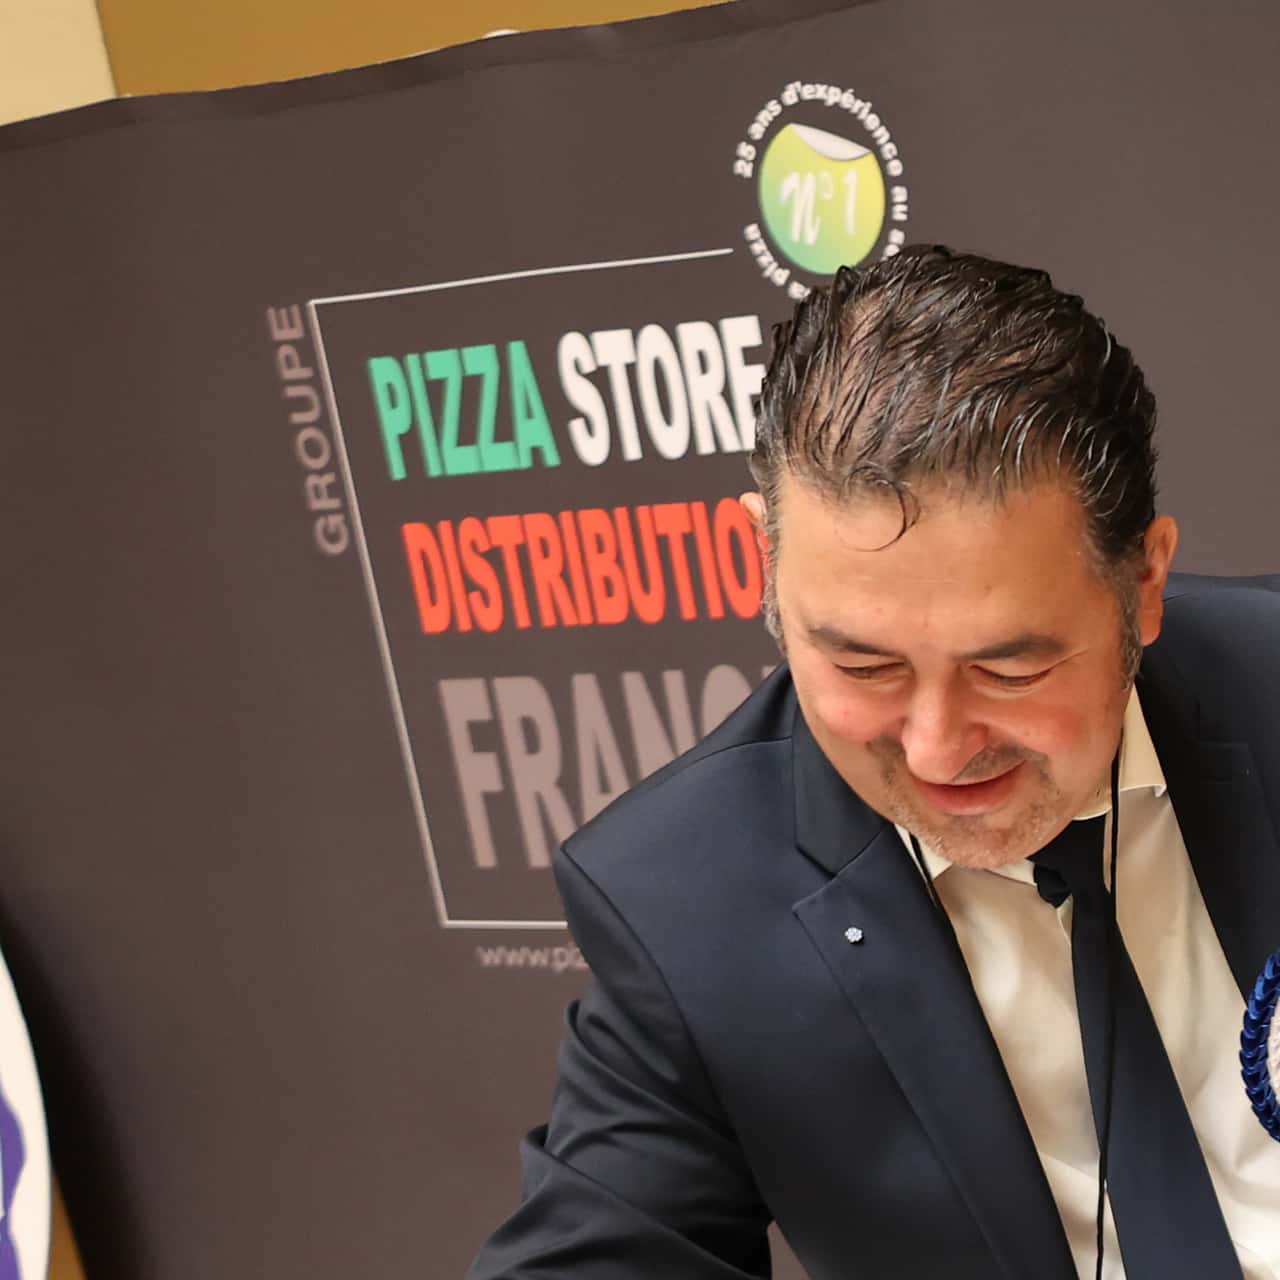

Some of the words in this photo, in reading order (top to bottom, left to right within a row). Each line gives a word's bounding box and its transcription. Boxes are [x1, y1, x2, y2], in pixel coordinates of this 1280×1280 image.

[733, 141, 757, 178] 25
[748, 99, 783, 140] ans
[781, 81, 904, 177] d'expérience
[891, 185, 908, 221] au
[265, 303, 350, 557] GROUPE
[367, 340, 561, 481] PIZZA
[401, 496, 769, 636] DISTRIBUTIO
[437, 663, 776, 870] FRAN
